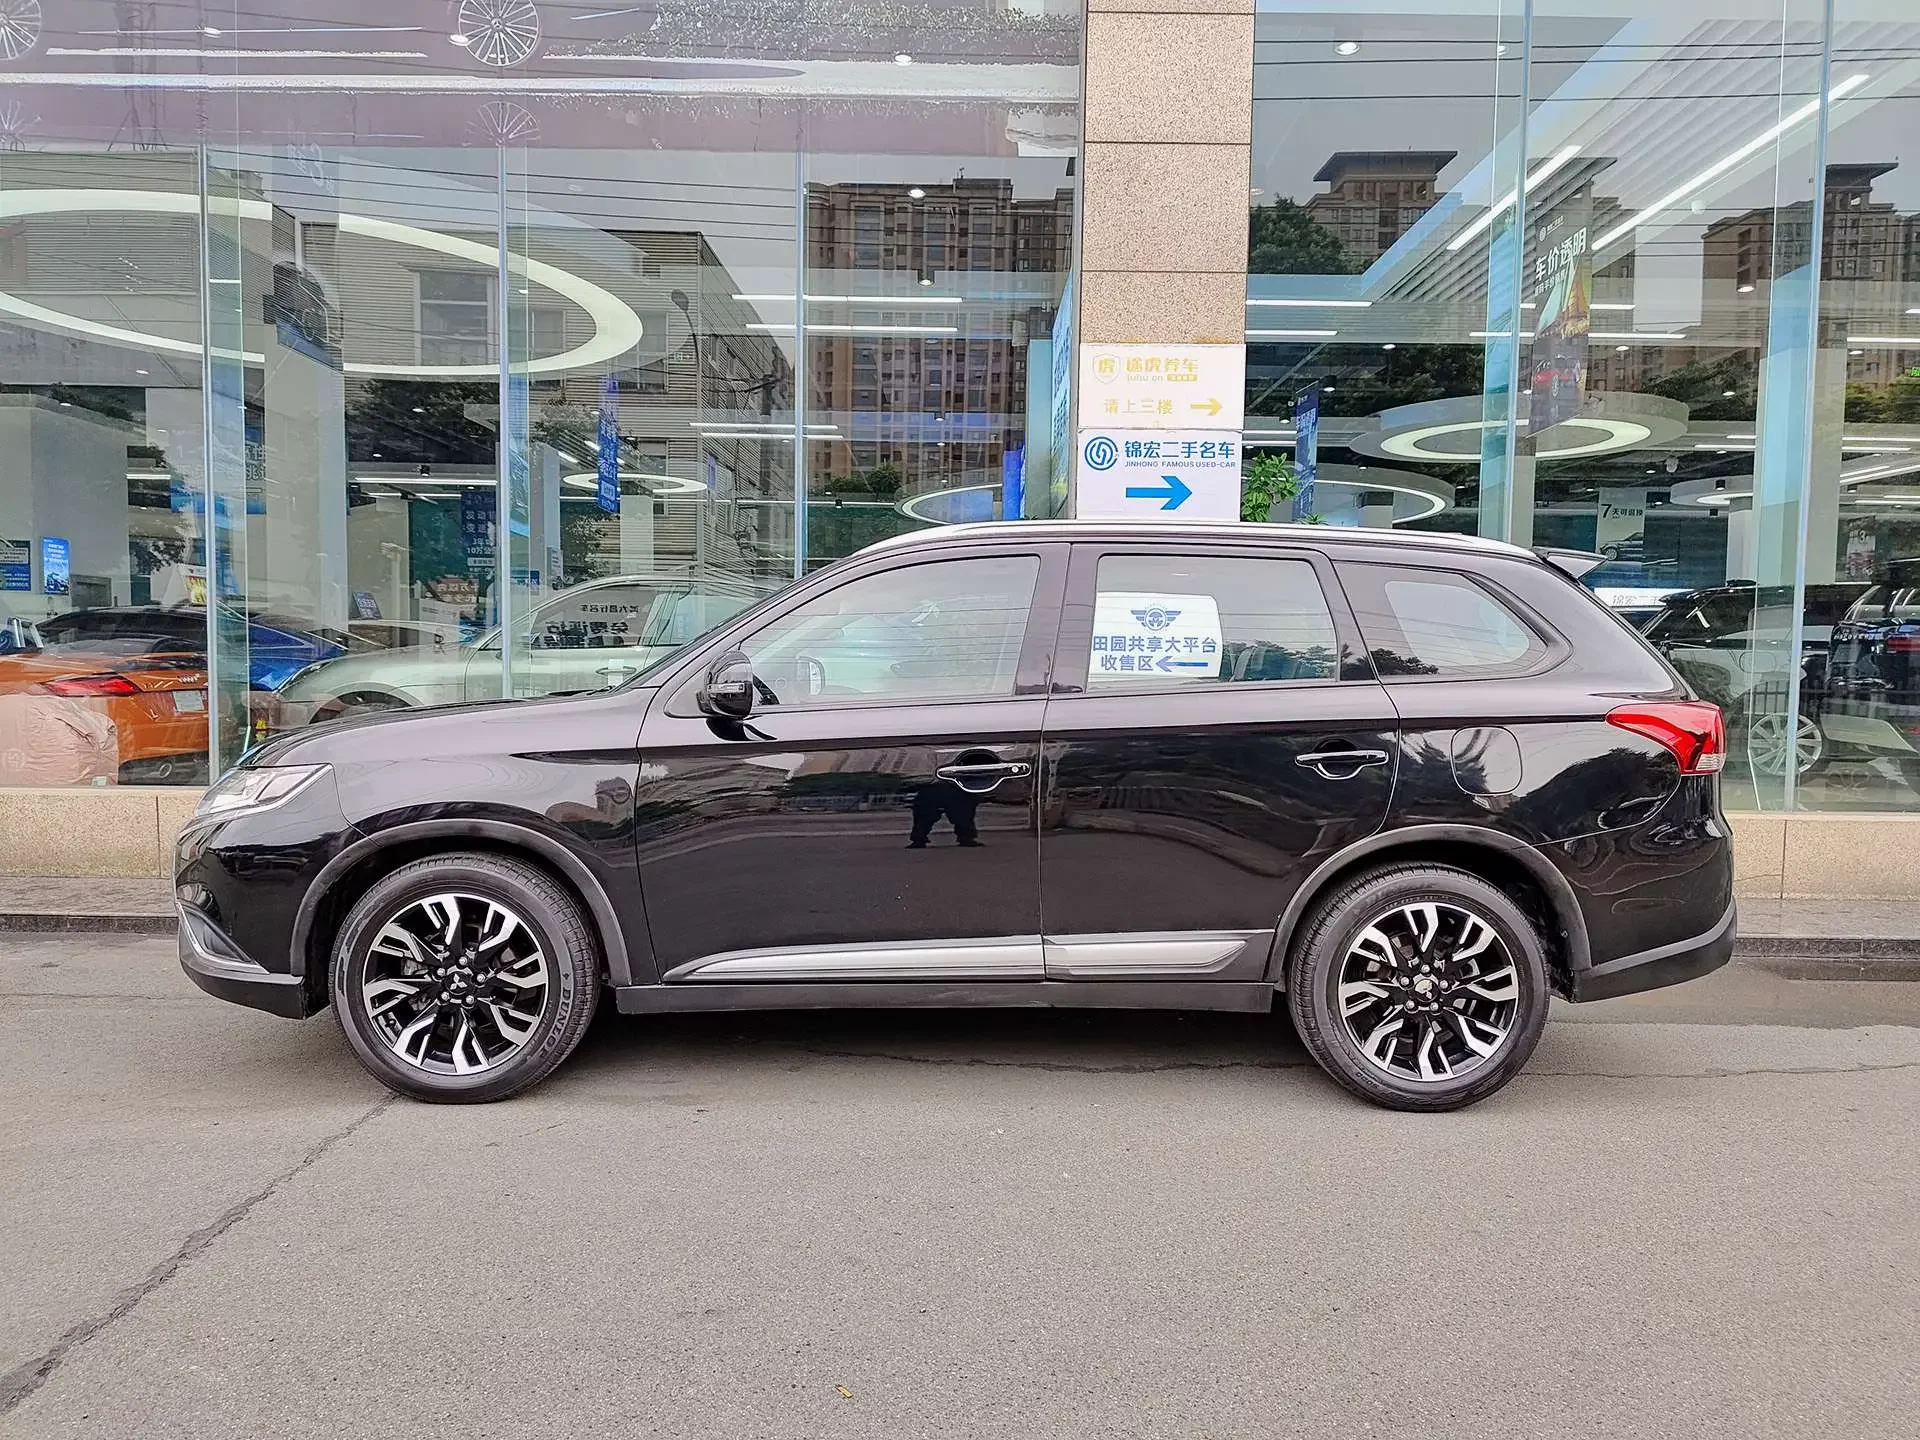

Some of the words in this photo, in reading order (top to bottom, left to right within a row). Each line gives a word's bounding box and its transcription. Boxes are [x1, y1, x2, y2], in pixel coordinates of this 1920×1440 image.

[1535, 226, 1587, 282] 车价透明
[1104, 398, 1173, 415] 请上三楼
[1124, 440, 1236, 459] 锦宏二手名车
[1124, 460, 1159, 468] JINHONG
[1161, 460, 1195, 468] FAMOUS
[1195, 460, 1236, 469] USED-CAR
[1092, 635, 1217, 653] 田园共享大平台
[1100, 655, 1154, 672] 收售区
[539, 987, 572, 1058] DUNLOP
